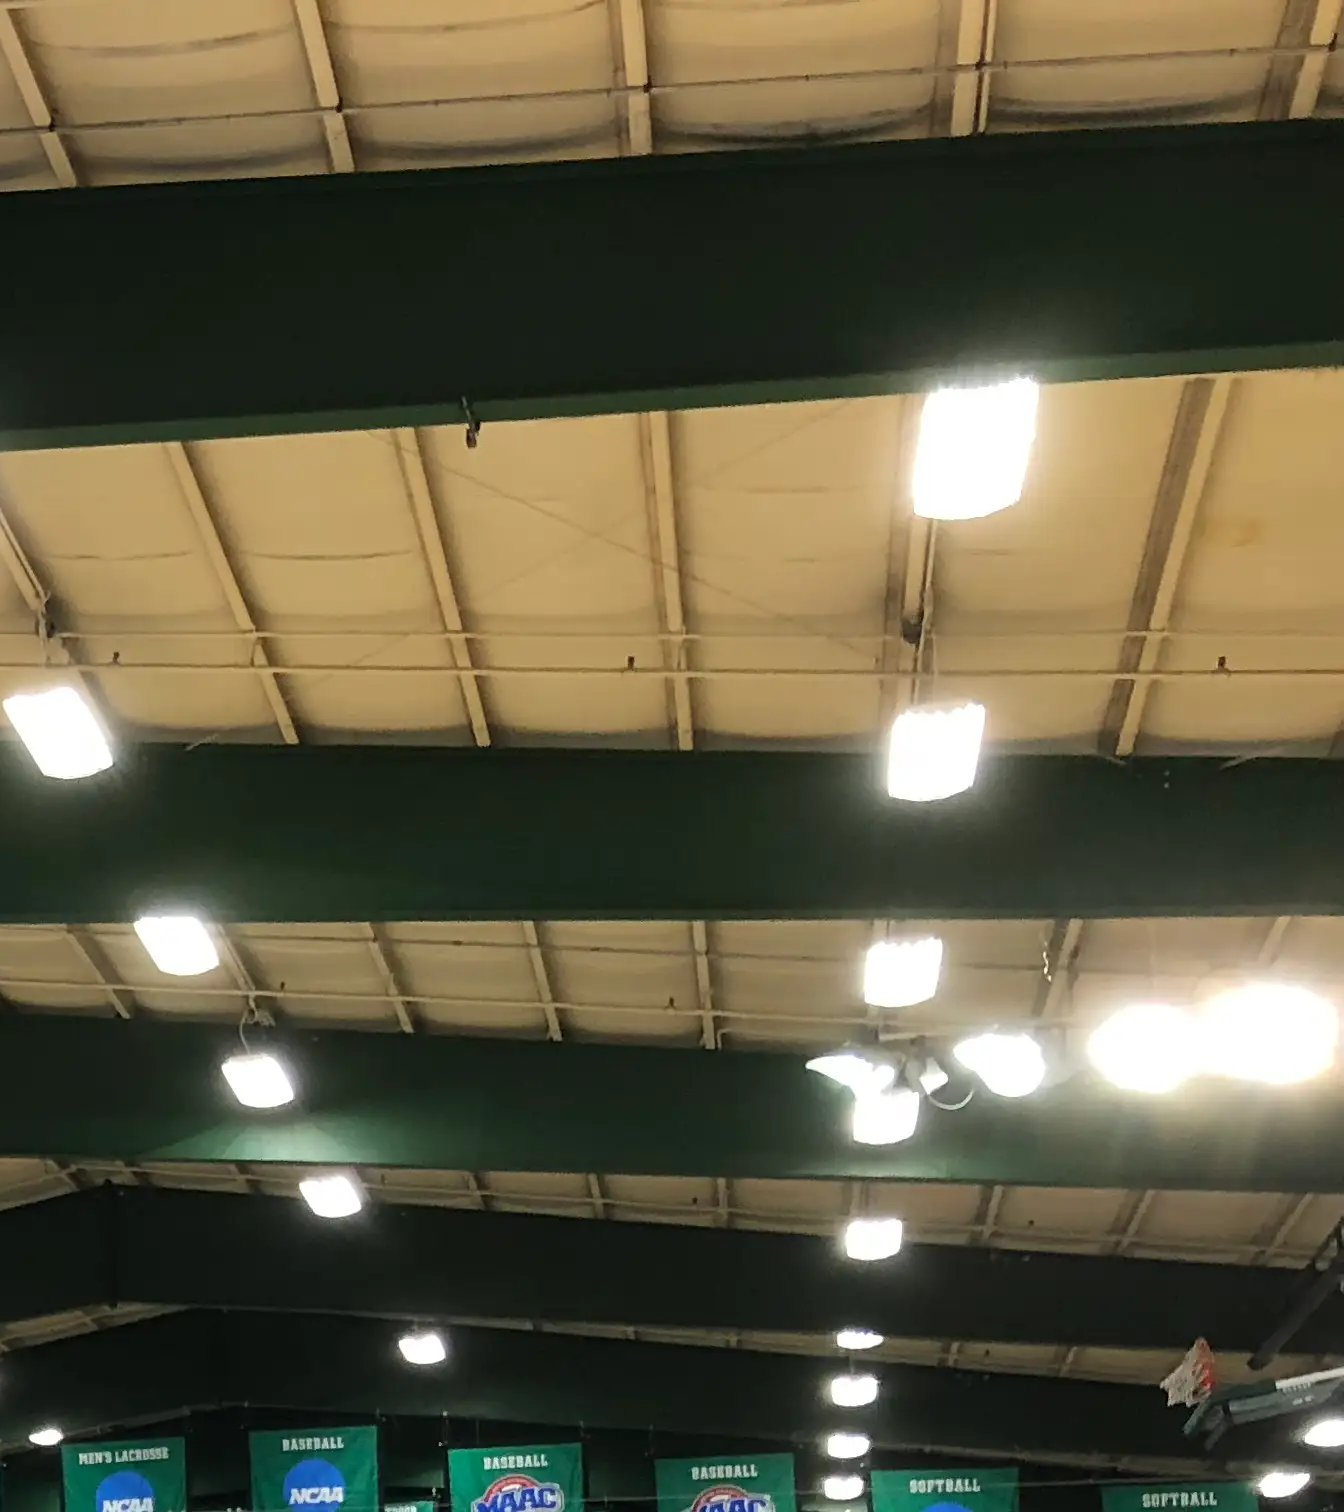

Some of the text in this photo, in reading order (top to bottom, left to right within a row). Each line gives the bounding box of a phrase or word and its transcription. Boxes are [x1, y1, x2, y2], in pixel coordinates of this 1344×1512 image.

[283, 1437, 344, 1451] BASEBALL
[79, 1447, 169, 1464] MEN'S LACROSSE
[484, 1455, 548, 1469] BASEBALL
[692, 1466, 758, 1480] BASEBALL
[910, 1479, 980, 1494] SOFTBALL
[289, 1486, 344, 1506] NCAA
[1142, 1493, 1217, 1508] SOFTBALL
